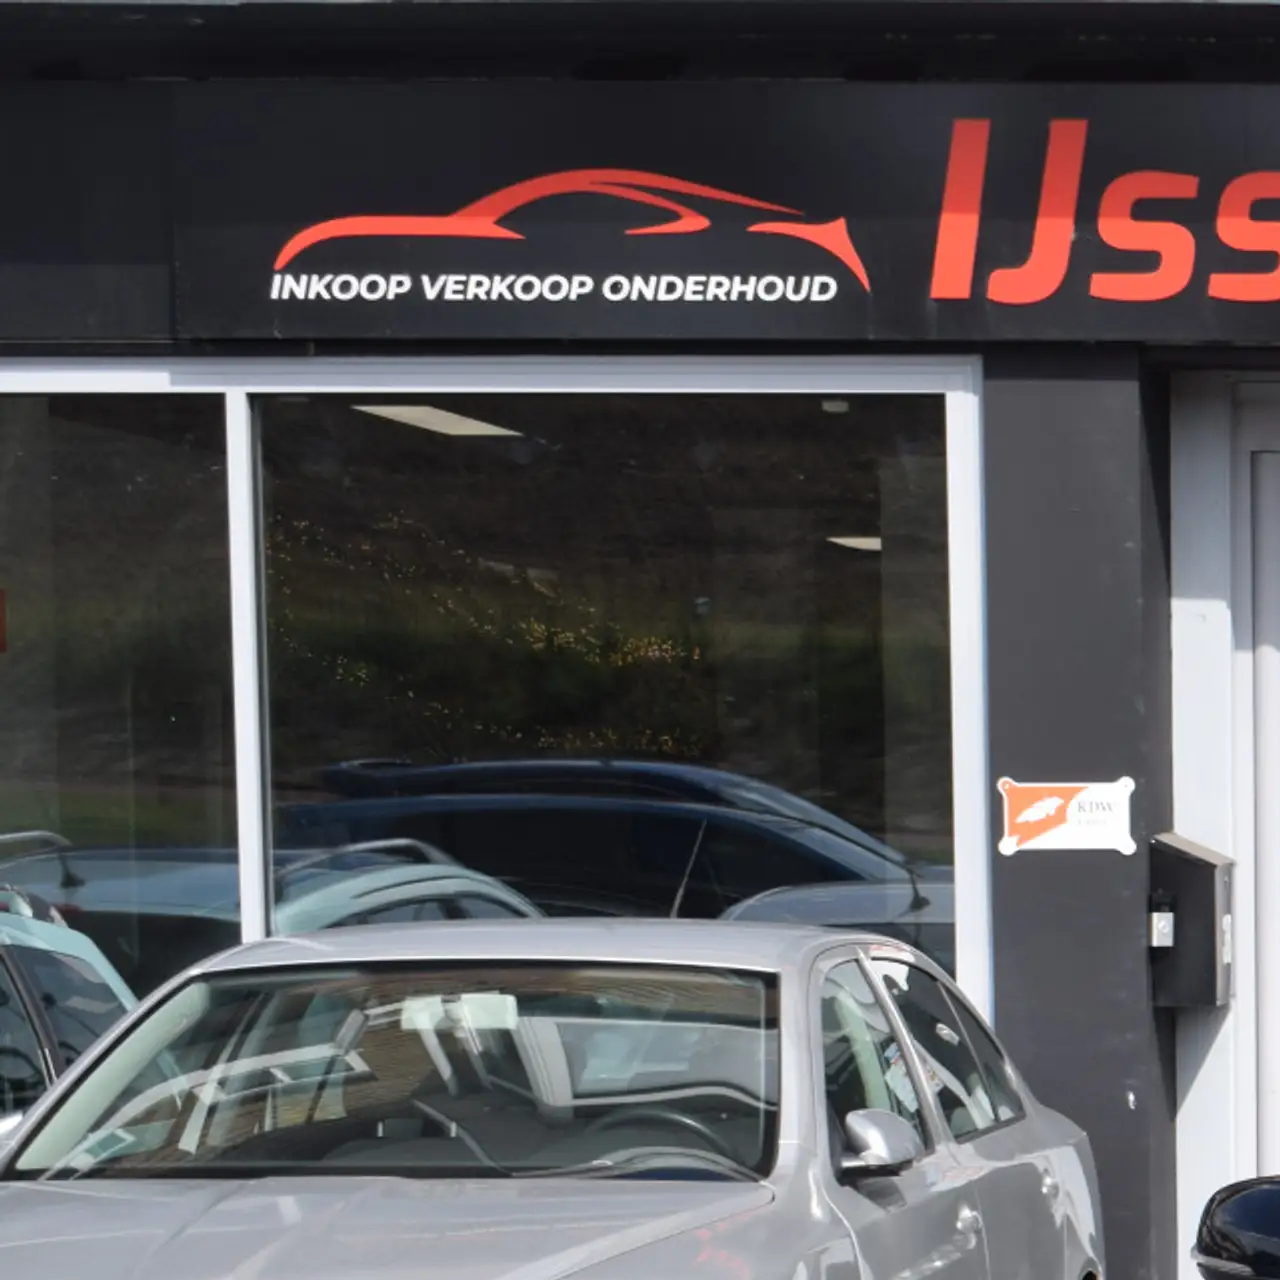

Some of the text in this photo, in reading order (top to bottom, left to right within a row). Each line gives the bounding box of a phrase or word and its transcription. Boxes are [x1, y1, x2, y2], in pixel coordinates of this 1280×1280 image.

[270, 273, 837, 302] INKOOP VERKOOP ONDERHOUD
